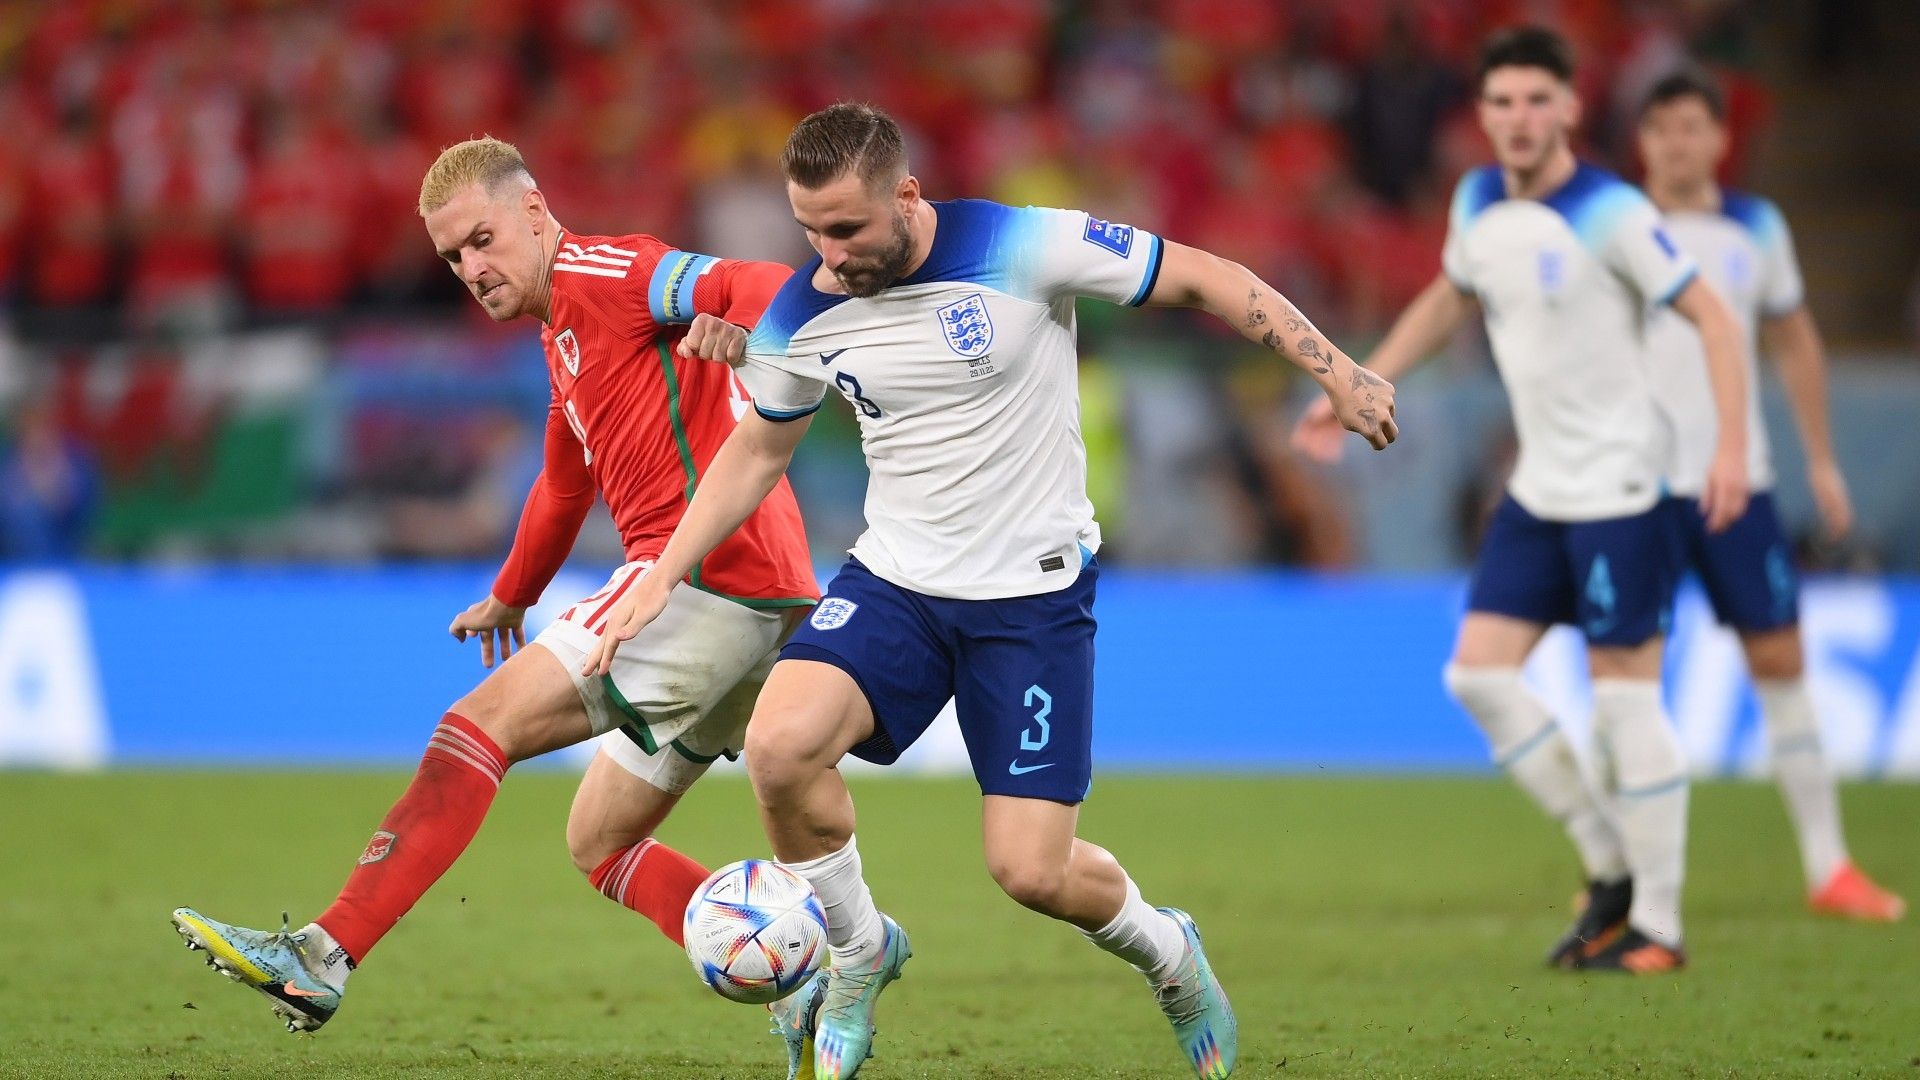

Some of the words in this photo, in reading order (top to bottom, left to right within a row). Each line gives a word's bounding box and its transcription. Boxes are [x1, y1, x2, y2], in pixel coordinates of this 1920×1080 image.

[671, 255, 700, 317] CHILDREN
[835, 371, 881, 418] 3
[970, 365, 994, 377] 29.11.22
[1020, 684, 1052, 751] 3
